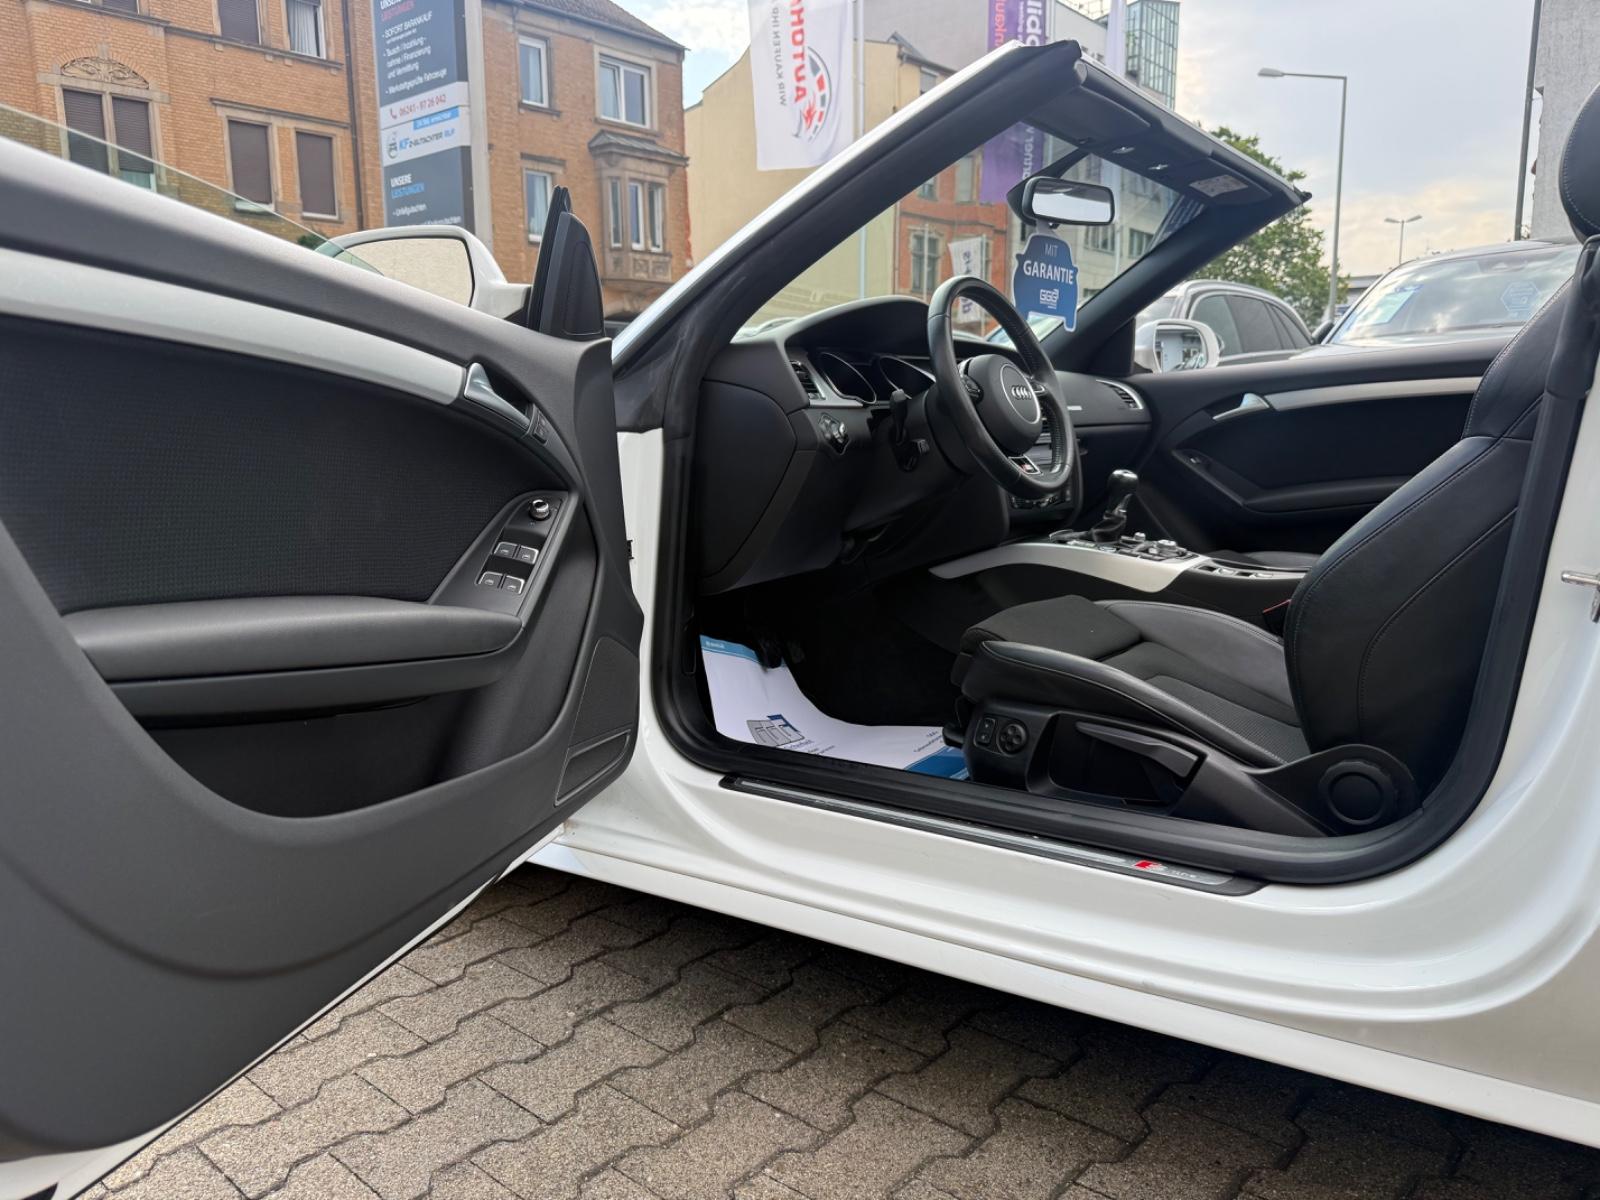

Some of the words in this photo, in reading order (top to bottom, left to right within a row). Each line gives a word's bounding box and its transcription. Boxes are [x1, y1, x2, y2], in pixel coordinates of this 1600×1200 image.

[390, 173, 412, 188] UNSERE
[1044, 243, 1059, 258] MIT
[1023, 260, 1075, 285] GARANTIE
